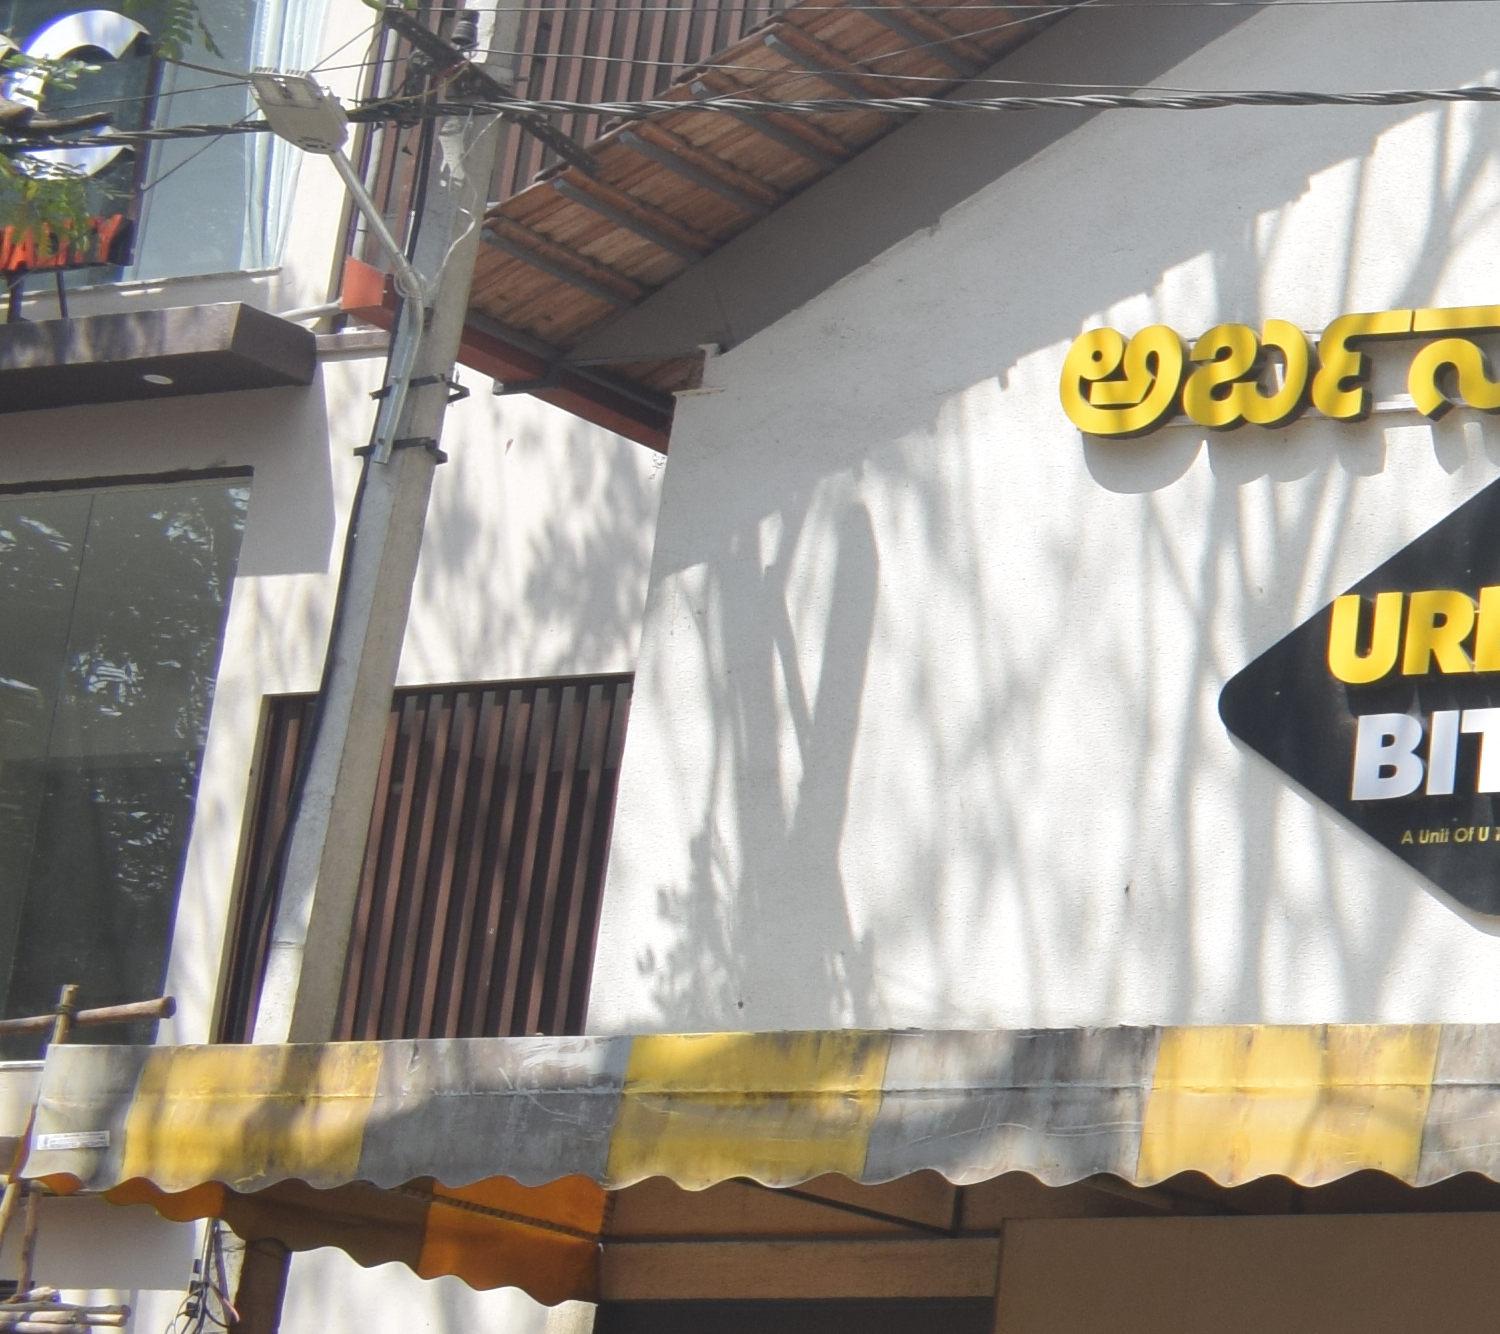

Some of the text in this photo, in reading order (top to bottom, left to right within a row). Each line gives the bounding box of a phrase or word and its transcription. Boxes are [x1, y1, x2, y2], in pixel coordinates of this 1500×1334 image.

[1401, 830, 1414, 845] A
[1419, 828, 1451, 845] Unit
[1454, 826, 1475, 844] Of
[1478, 827, 1490, 843] U
